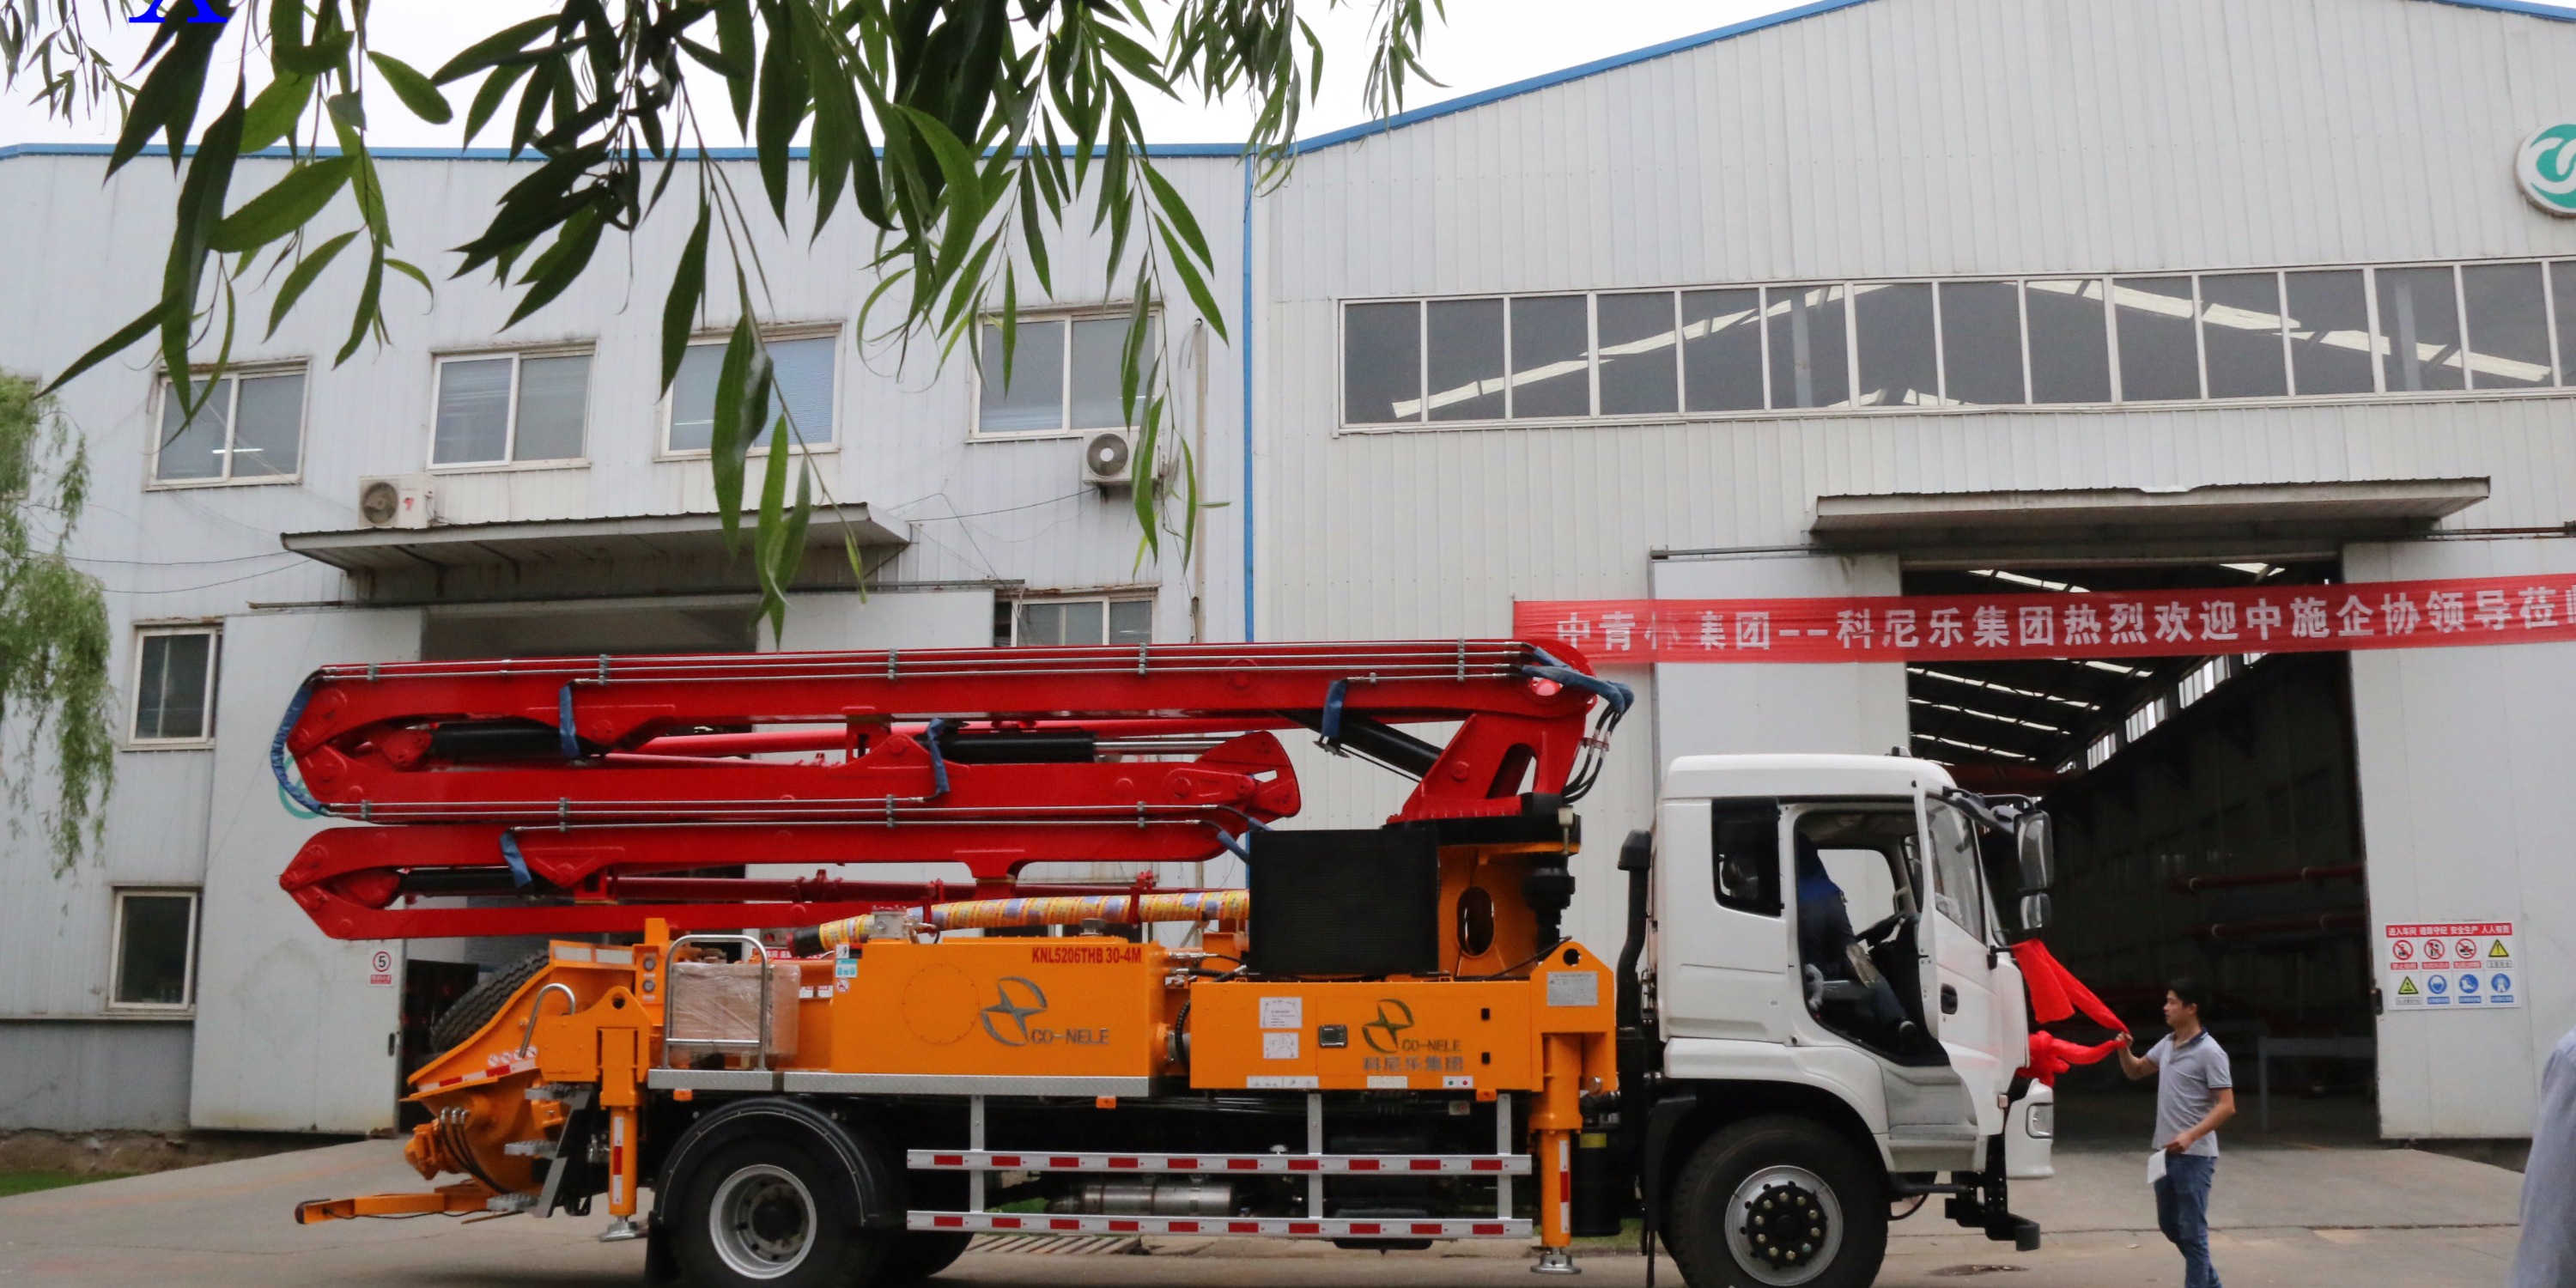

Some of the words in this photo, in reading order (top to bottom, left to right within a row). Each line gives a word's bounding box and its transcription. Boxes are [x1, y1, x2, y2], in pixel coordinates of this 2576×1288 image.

[2450, 926, 2479, 935] 安全生产
[379, 956, 386, 968] 5
[1032, 947, 1103, 963] KNL5206THB
[1106, 947, 1142, 963] 30-4M
[1031, 1029, 1109, 1045] CO-NELE
[1401, 1039, 1461, 1052] CO-NELE
[1363, 1055, 1464, 1072] 科尼乐集团
